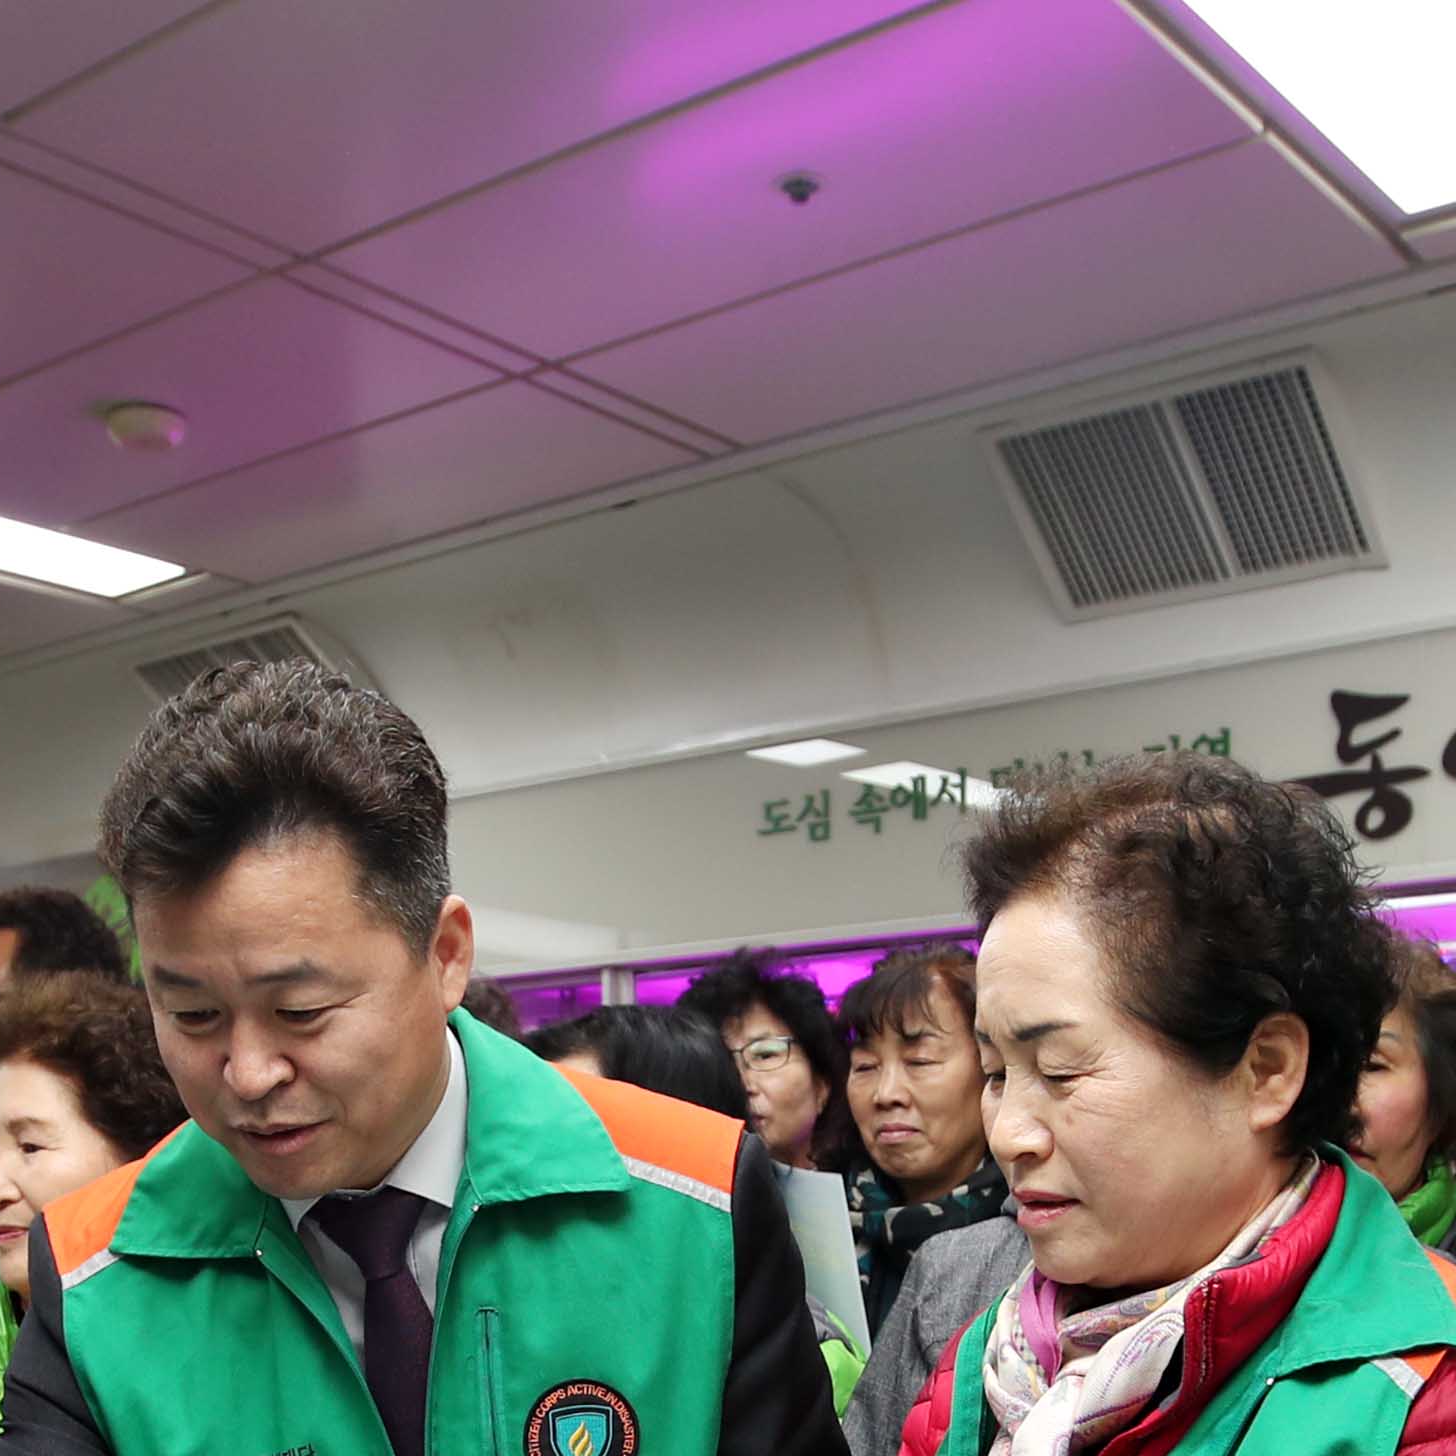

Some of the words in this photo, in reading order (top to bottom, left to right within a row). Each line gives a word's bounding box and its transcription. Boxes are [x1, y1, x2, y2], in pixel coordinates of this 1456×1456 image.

[757, 788, 831, 842] 도심
[848, 766, 967, 835] 속에서
[536, 1388, 566, 1417] CORPS
[567, 1384, 607, 1398] ACTIVE
